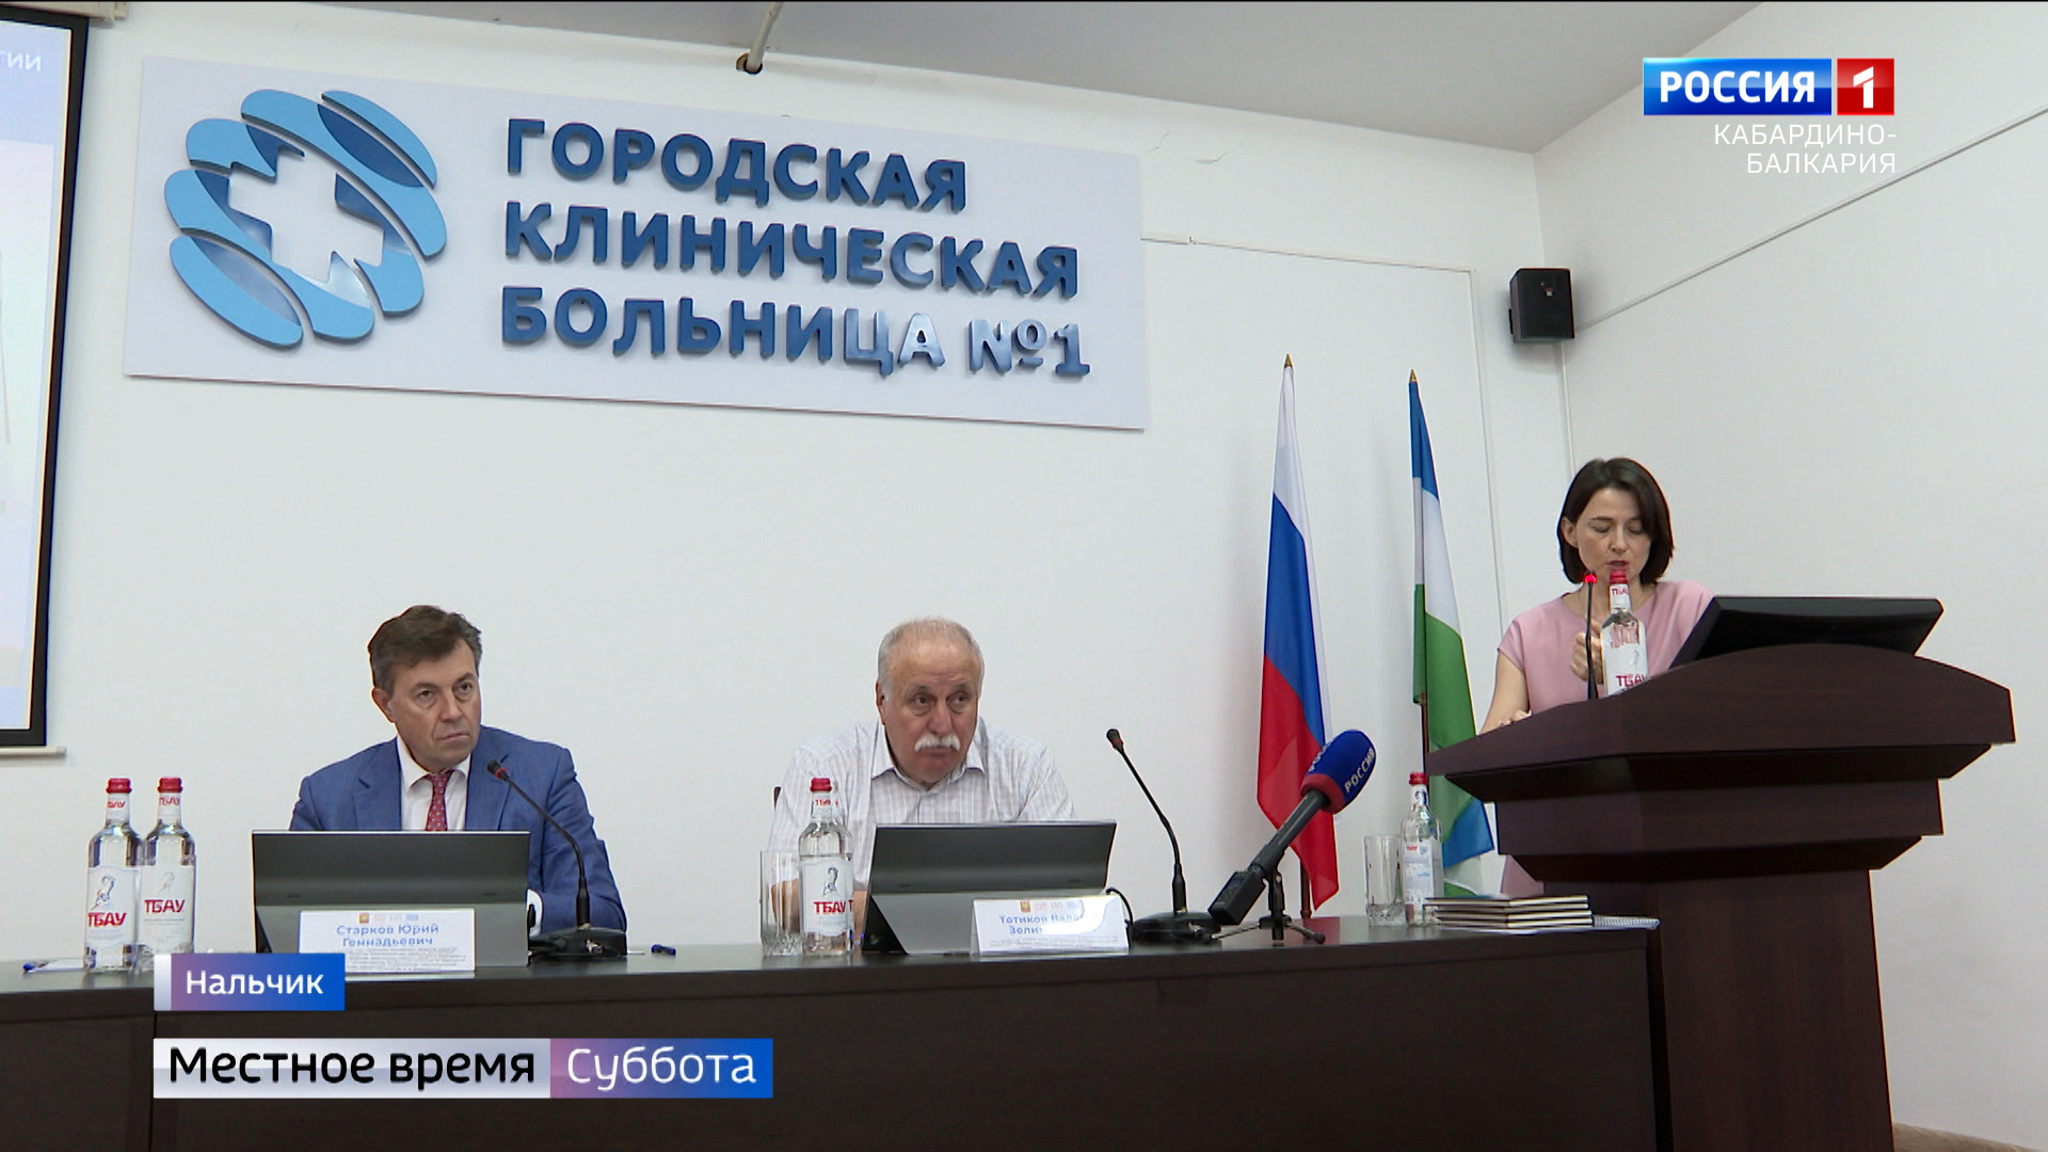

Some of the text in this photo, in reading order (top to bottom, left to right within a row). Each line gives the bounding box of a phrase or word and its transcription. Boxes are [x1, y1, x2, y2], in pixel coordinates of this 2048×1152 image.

[506, 118, 967, 212] ГОРОДСКАЯ
[504, 200, 1079, 300] КЛИНИЧЕСКАЯ
[501, 285, 1091, 378] БОЛЬНИЦА №1
[1344, 747, 1376, 793] РОССИЯ
[144, 899, 186, 914] ТБАУ
[813, 901, 846, 914] ТБАУ
[87, 912, 127, 928] ТБАУ
[336, 922, 440, 937] Старков Юрий
[342, 937, 434, 947] Геннадьевич
